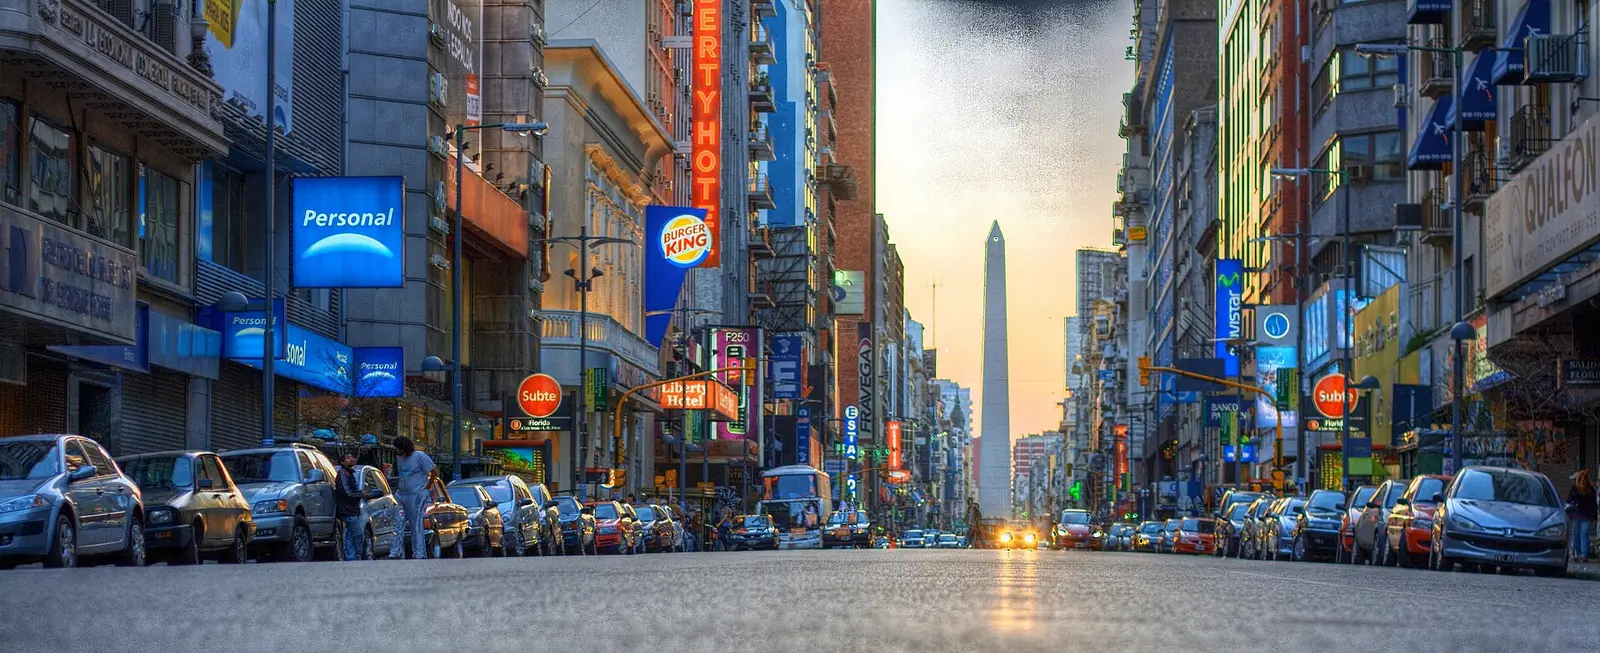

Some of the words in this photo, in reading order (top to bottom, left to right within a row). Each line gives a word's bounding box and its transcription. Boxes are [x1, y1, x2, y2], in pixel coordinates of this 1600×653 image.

[697, 0, 718, 114] ERTY
[1525, 126, 1597, 235] QUALFON
[303, 207, 394, 227] Personal
[663, 223, 706, 244] BURGER
[665, 233, 707, 258] KING
[232, 315, 277, 326] Personl
[725, 332, 750, 342] F250
[361, 361, 398, 371] Personal
[661, 382, 707, 395] Liberty
[860, 350, 874, 434] FRAVEGA
[522, 390, 557, 401] Subte
[667, 395, 703, 406] Hotel
[1210, 402, 1239, 412] BANCO
[1325, 419, 1345, 427] Florid
